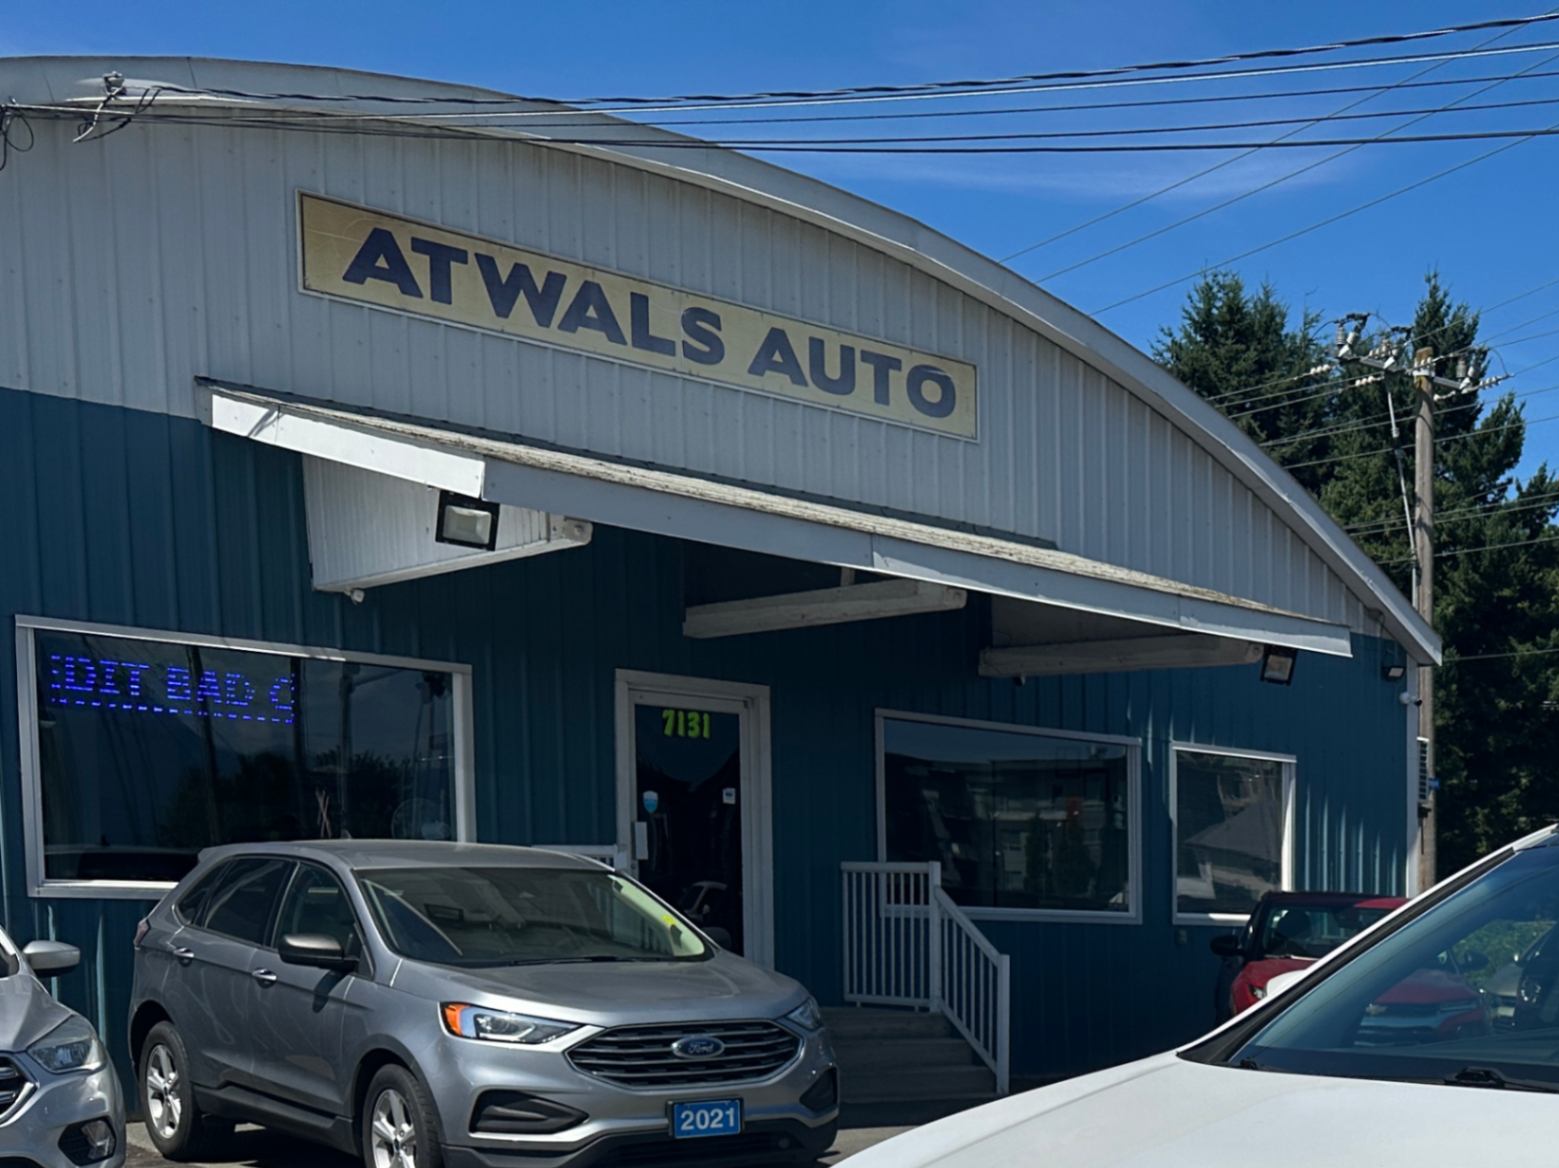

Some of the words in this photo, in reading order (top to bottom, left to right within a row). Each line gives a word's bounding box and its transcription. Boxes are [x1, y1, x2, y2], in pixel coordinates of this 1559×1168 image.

[342, 227, 726, 366] ATWALS
[747, 326, 957, 419] AUTO
[168, 667, 255, 706] BAD
[662, 708, 711, 739] 7131
[680, 1107, 735, 1131] 2021
